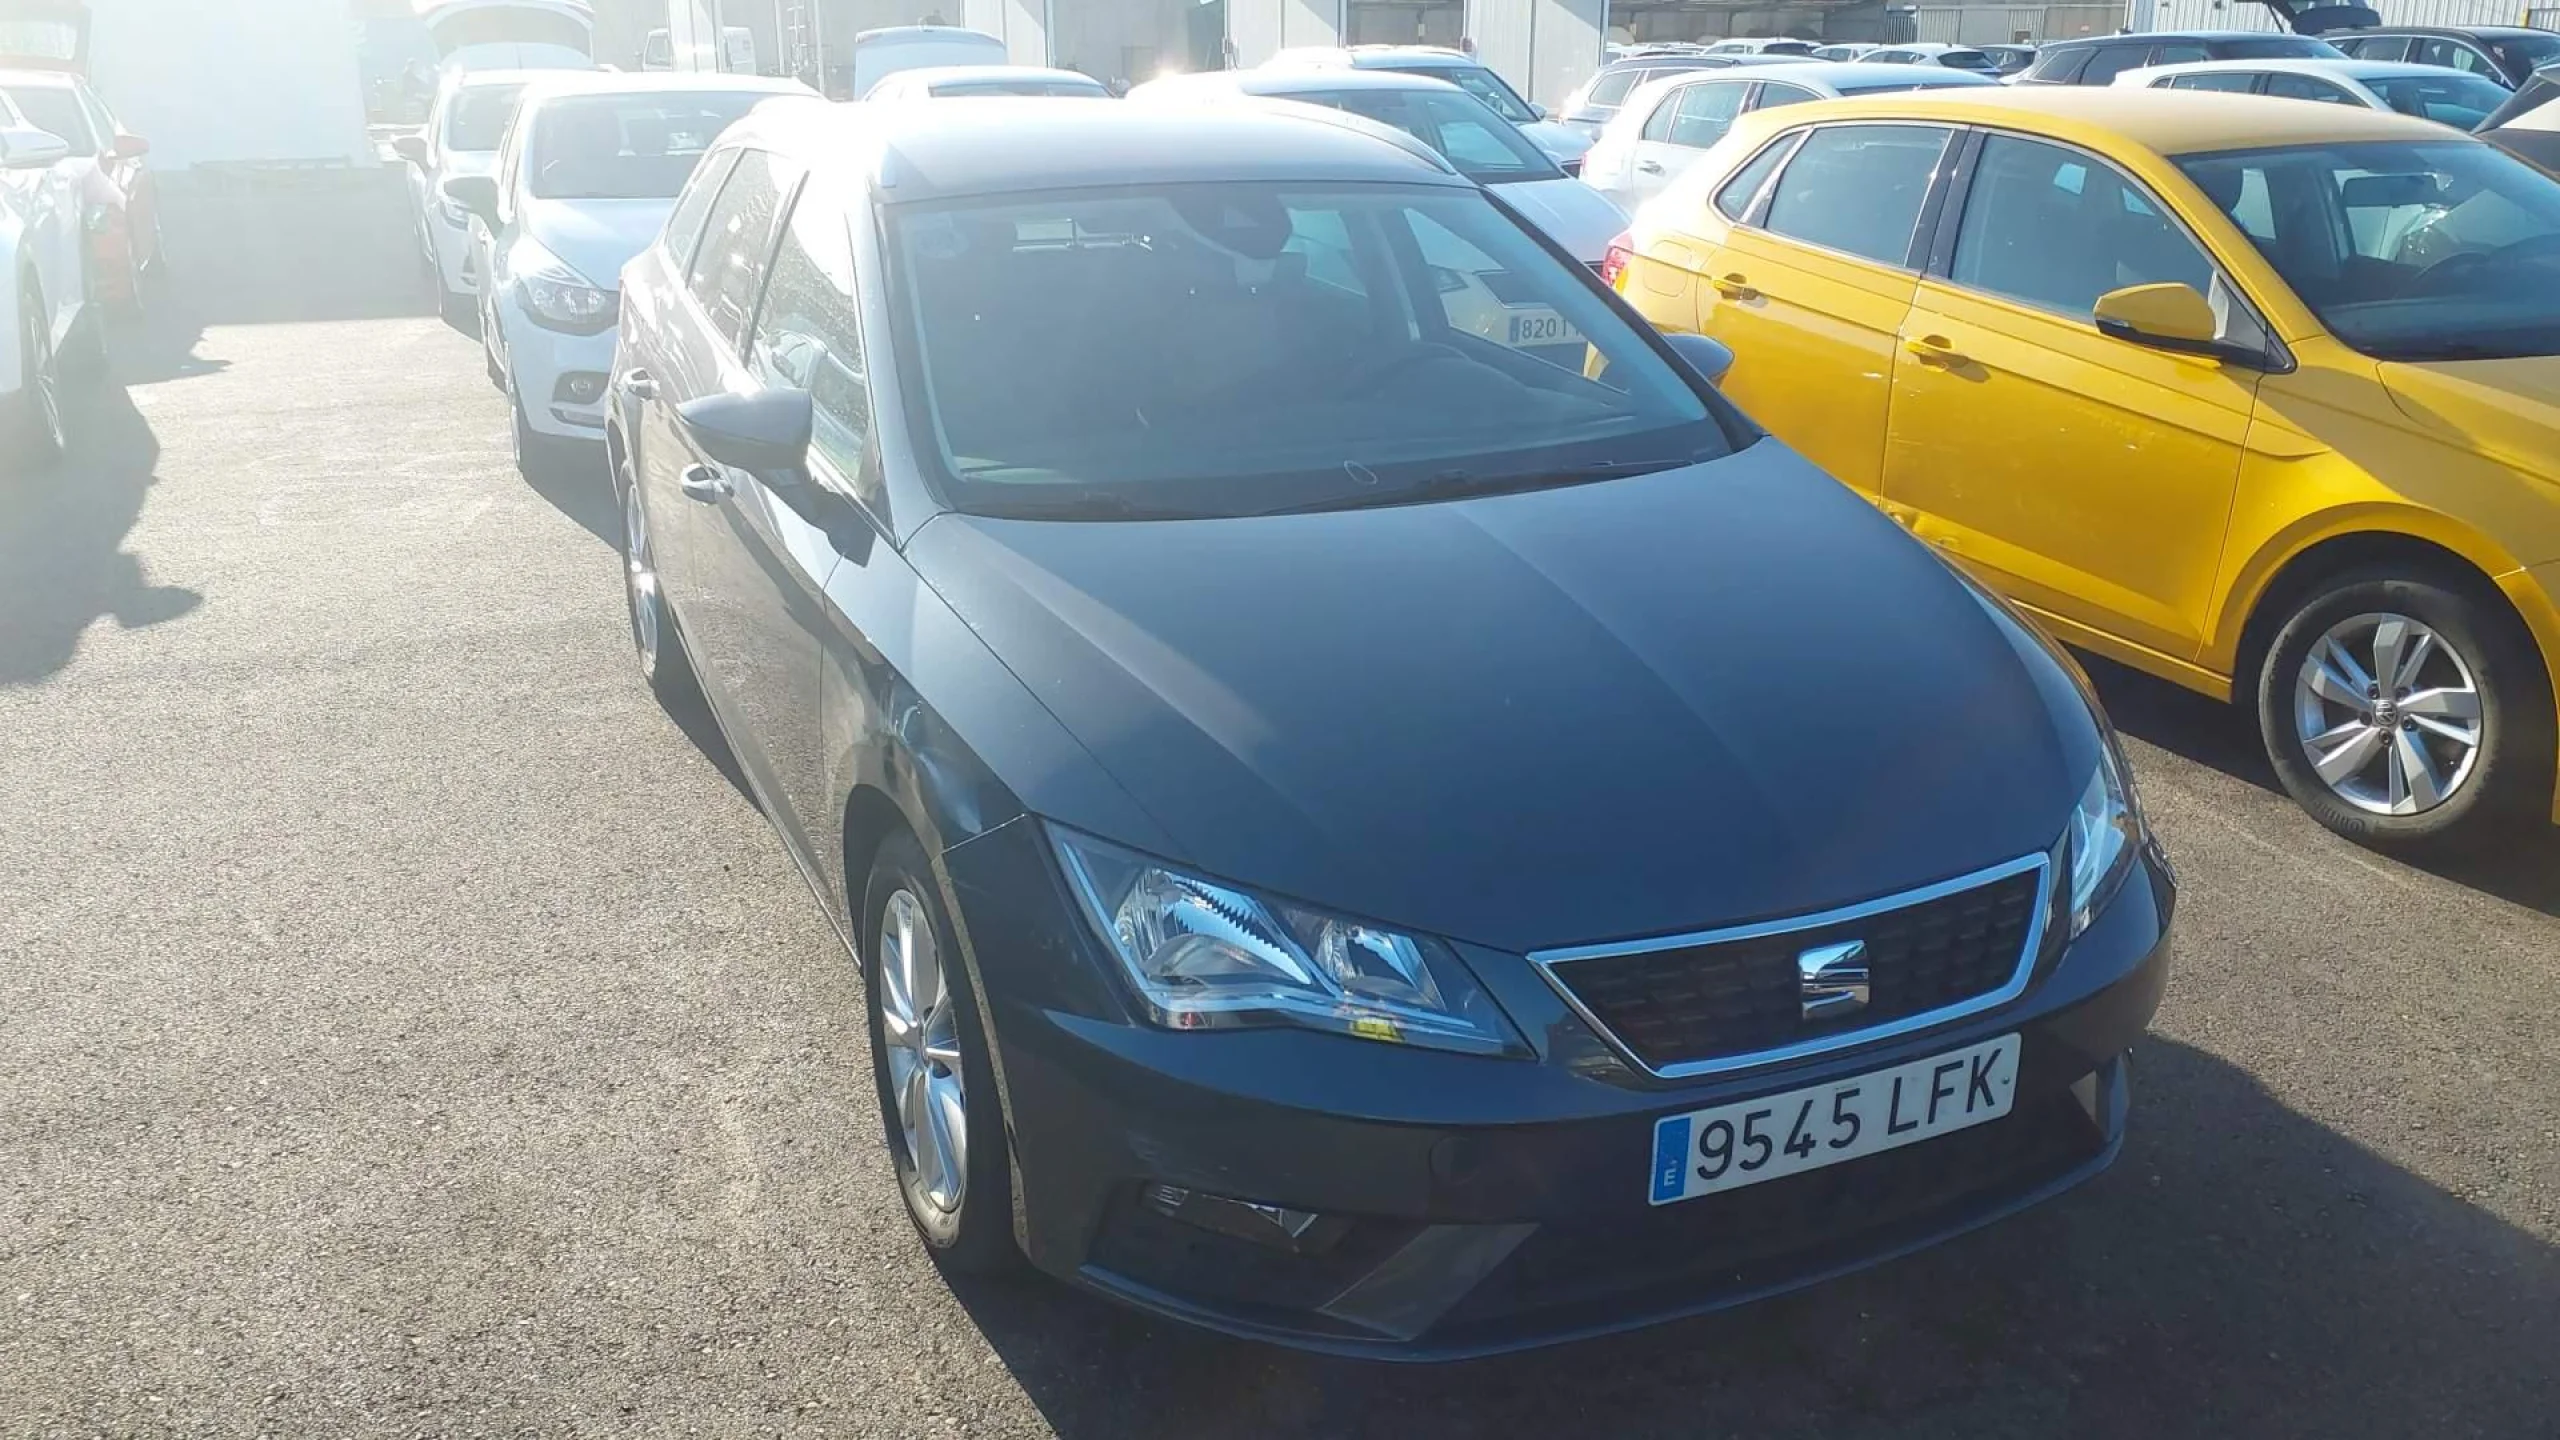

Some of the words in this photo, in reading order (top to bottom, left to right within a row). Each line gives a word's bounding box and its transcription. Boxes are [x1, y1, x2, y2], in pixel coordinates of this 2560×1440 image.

[1663, 1167, 1677, 1187] E
[1697, 1088, 1861, 1180] 9545
[1887, 1048, 2002, 1136] LFK
